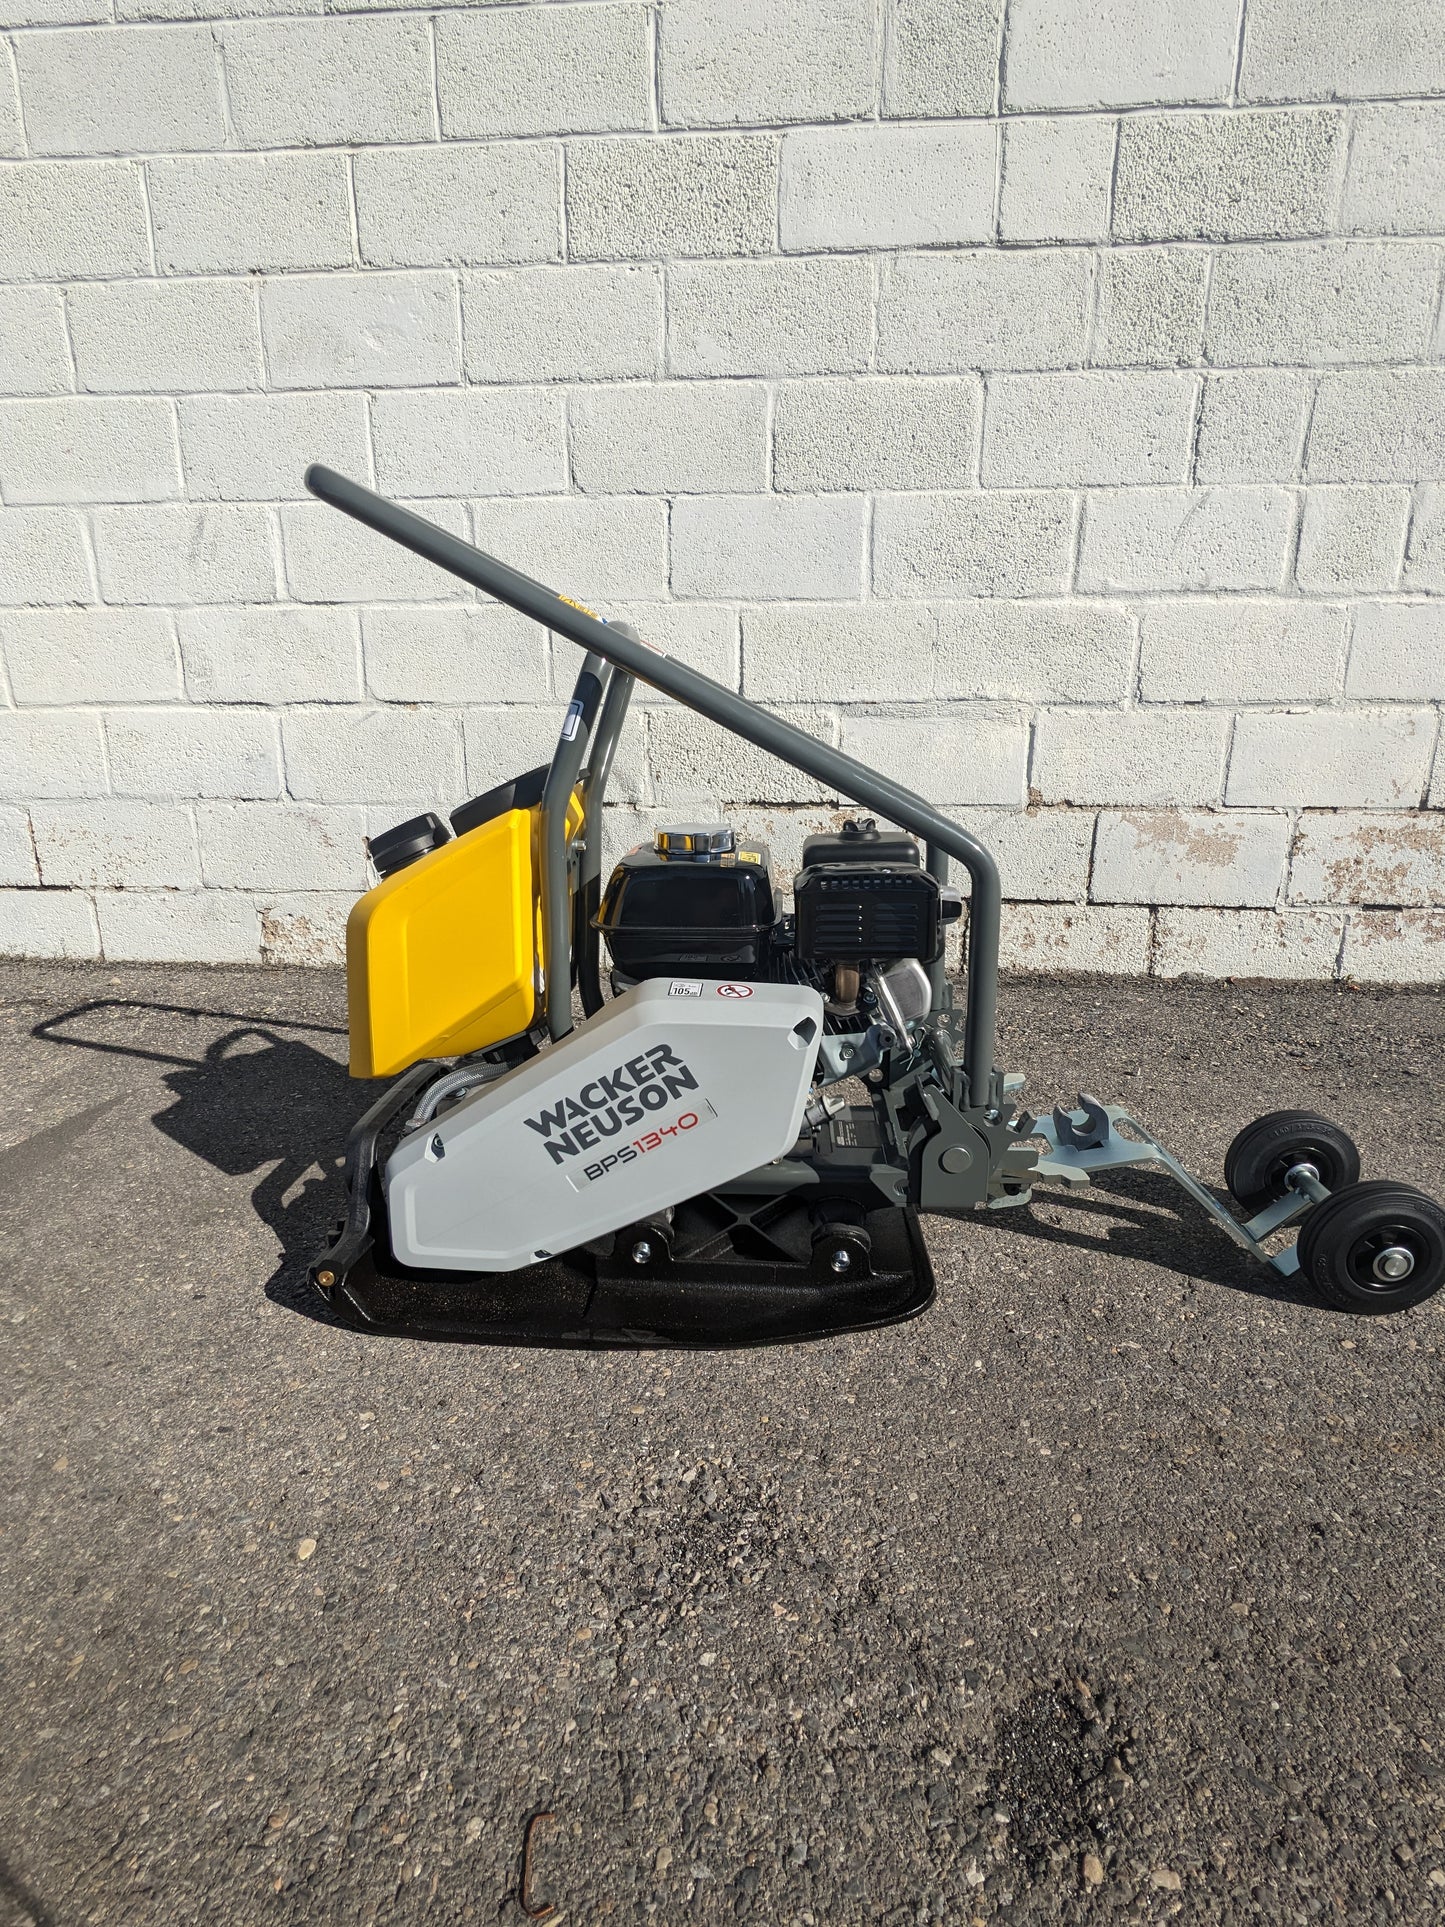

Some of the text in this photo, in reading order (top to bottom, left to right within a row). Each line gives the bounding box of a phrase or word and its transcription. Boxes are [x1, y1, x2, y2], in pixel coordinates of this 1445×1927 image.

[673, 987, 690, 995] 105
[523, 1044, 684, 1138] WACKER
[543, 1065, 699, 1165] NEUSON
[583, 1112, 698, 1181] BPS1340
